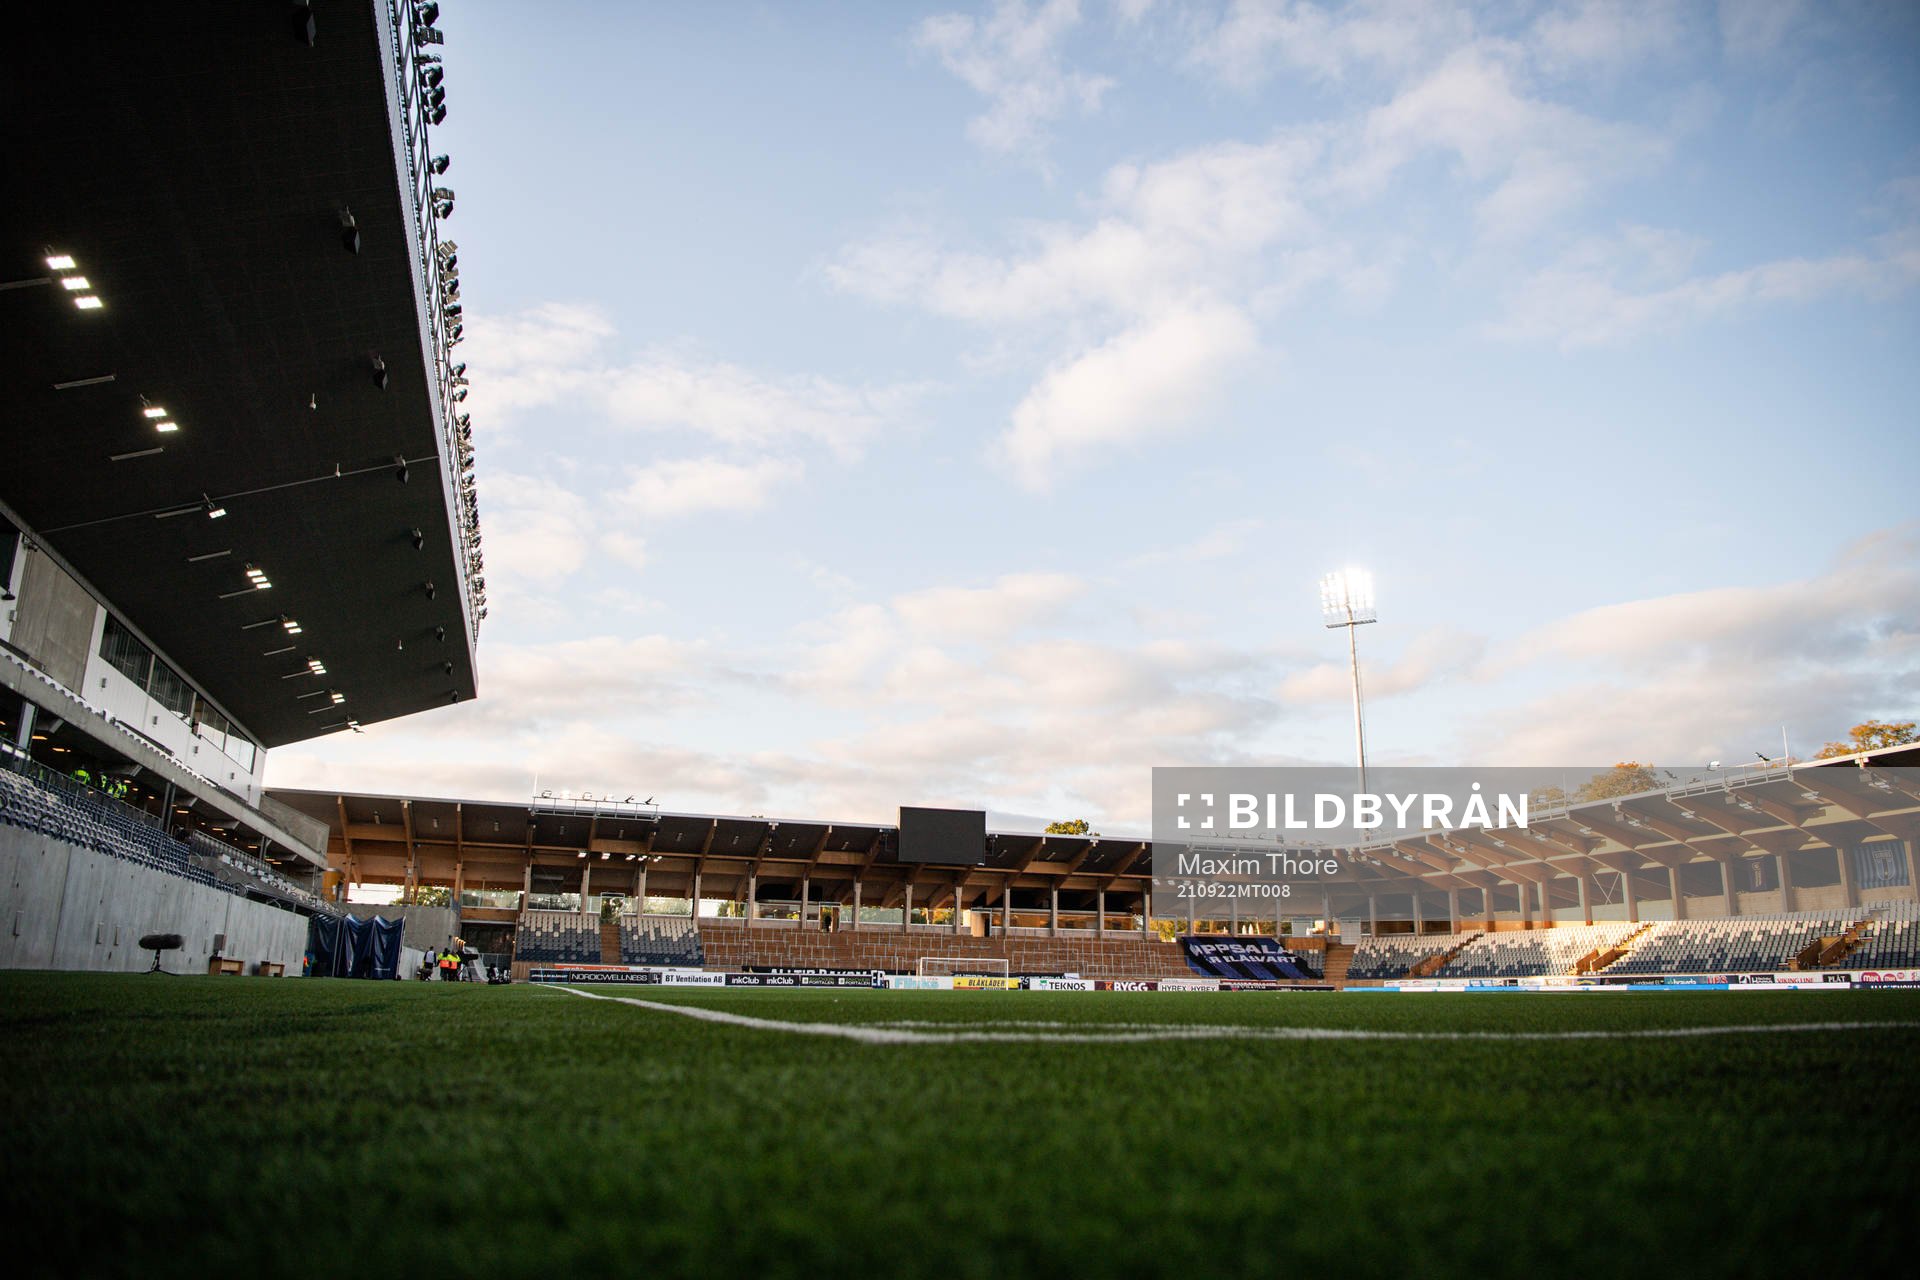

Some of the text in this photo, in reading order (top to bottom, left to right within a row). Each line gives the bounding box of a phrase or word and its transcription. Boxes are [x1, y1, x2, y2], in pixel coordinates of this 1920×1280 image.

[665, 974, 674, 983] BT
[676, 974, 712, 983] Ventilation
[1048, 981, 1086, 991] TEKNOS
